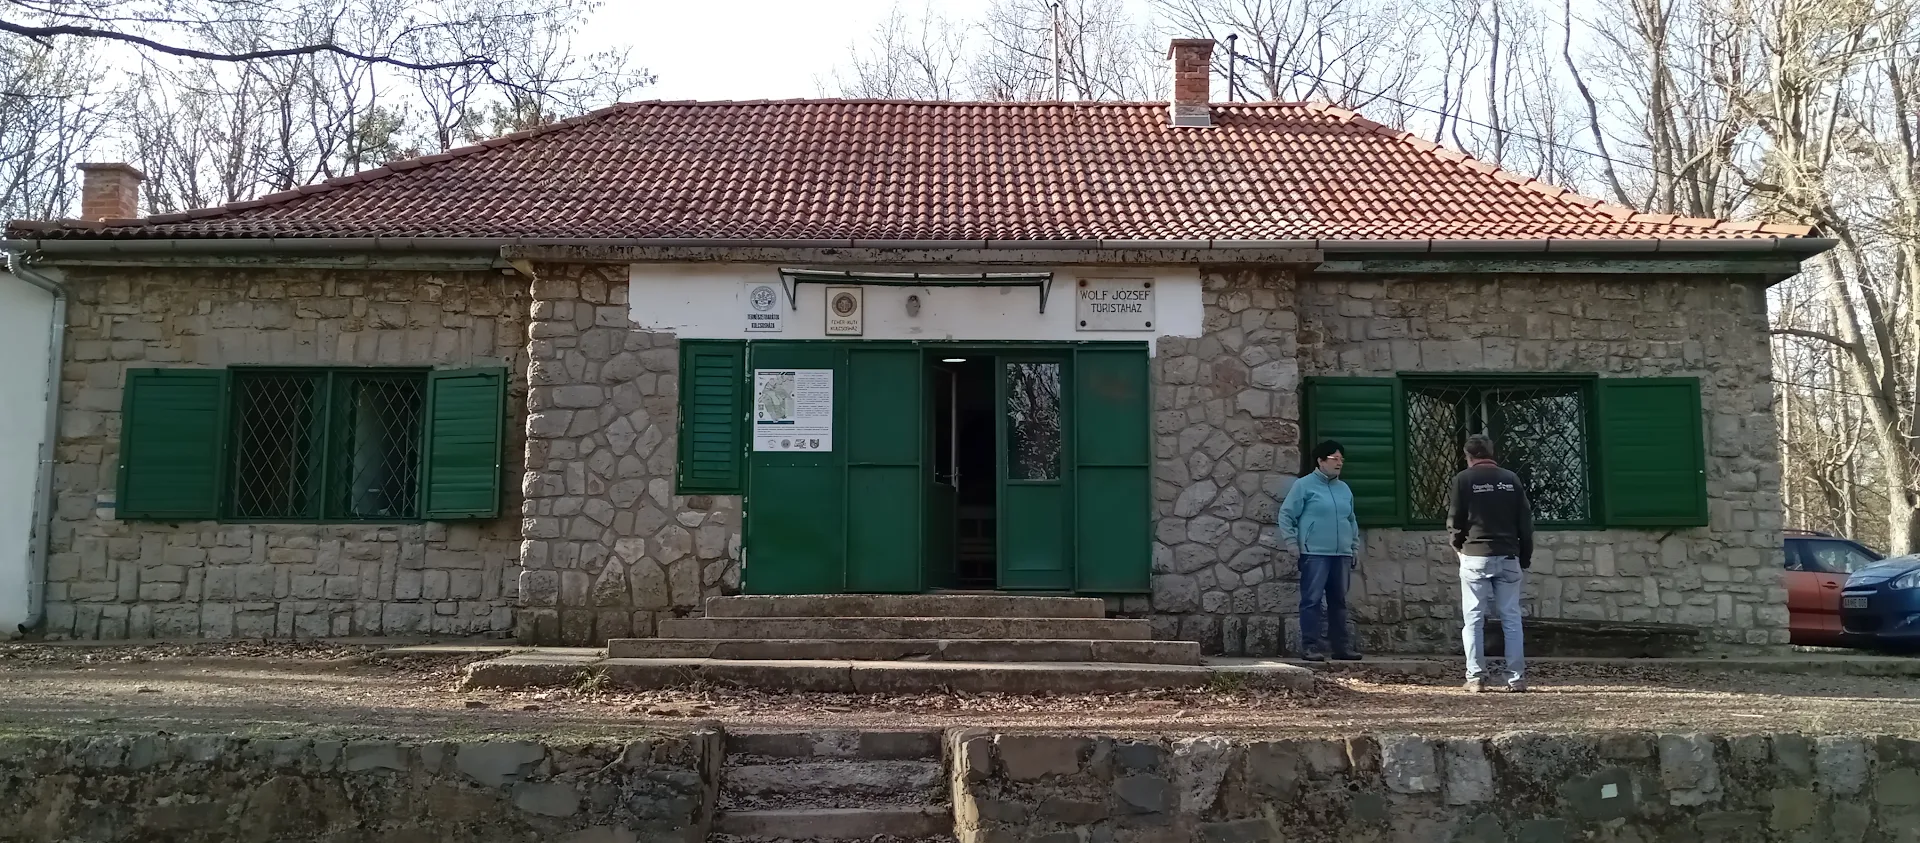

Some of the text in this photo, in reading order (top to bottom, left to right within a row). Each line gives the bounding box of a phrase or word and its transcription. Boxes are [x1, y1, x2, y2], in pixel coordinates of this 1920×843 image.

[1080, 288, 1151, 300] WOLF JÓZSEF
[1091, 302, 1142, 313] TURISTAHÁZ
